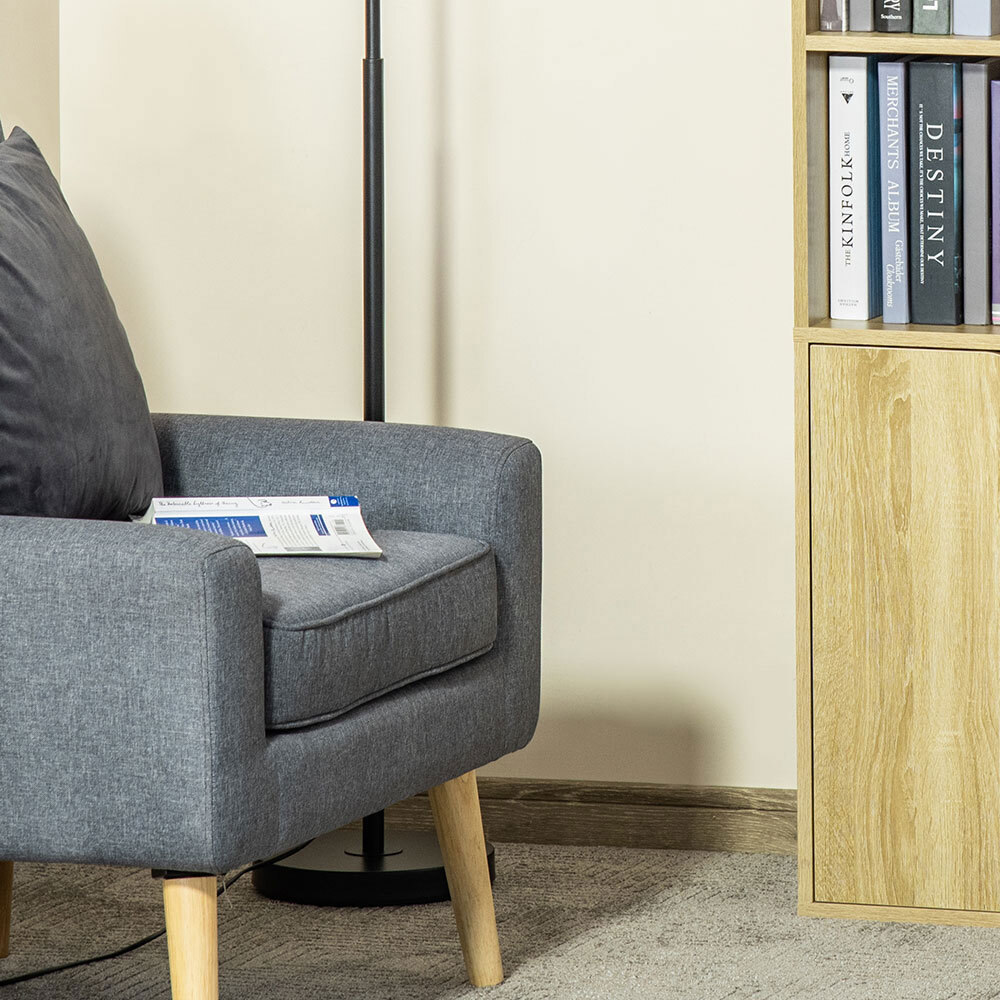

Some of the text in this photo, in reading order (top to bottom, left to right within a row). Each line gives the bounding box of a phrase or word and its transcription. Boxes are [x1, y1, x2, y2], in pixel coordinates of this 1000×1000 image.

[841, 158, 854, 248] KINFOLK
[886, 75, 900, 233] MERCHANTS ALBUM
[926, 122, 945, 267] DESTINY
[844, 249, 852, 267] THE
